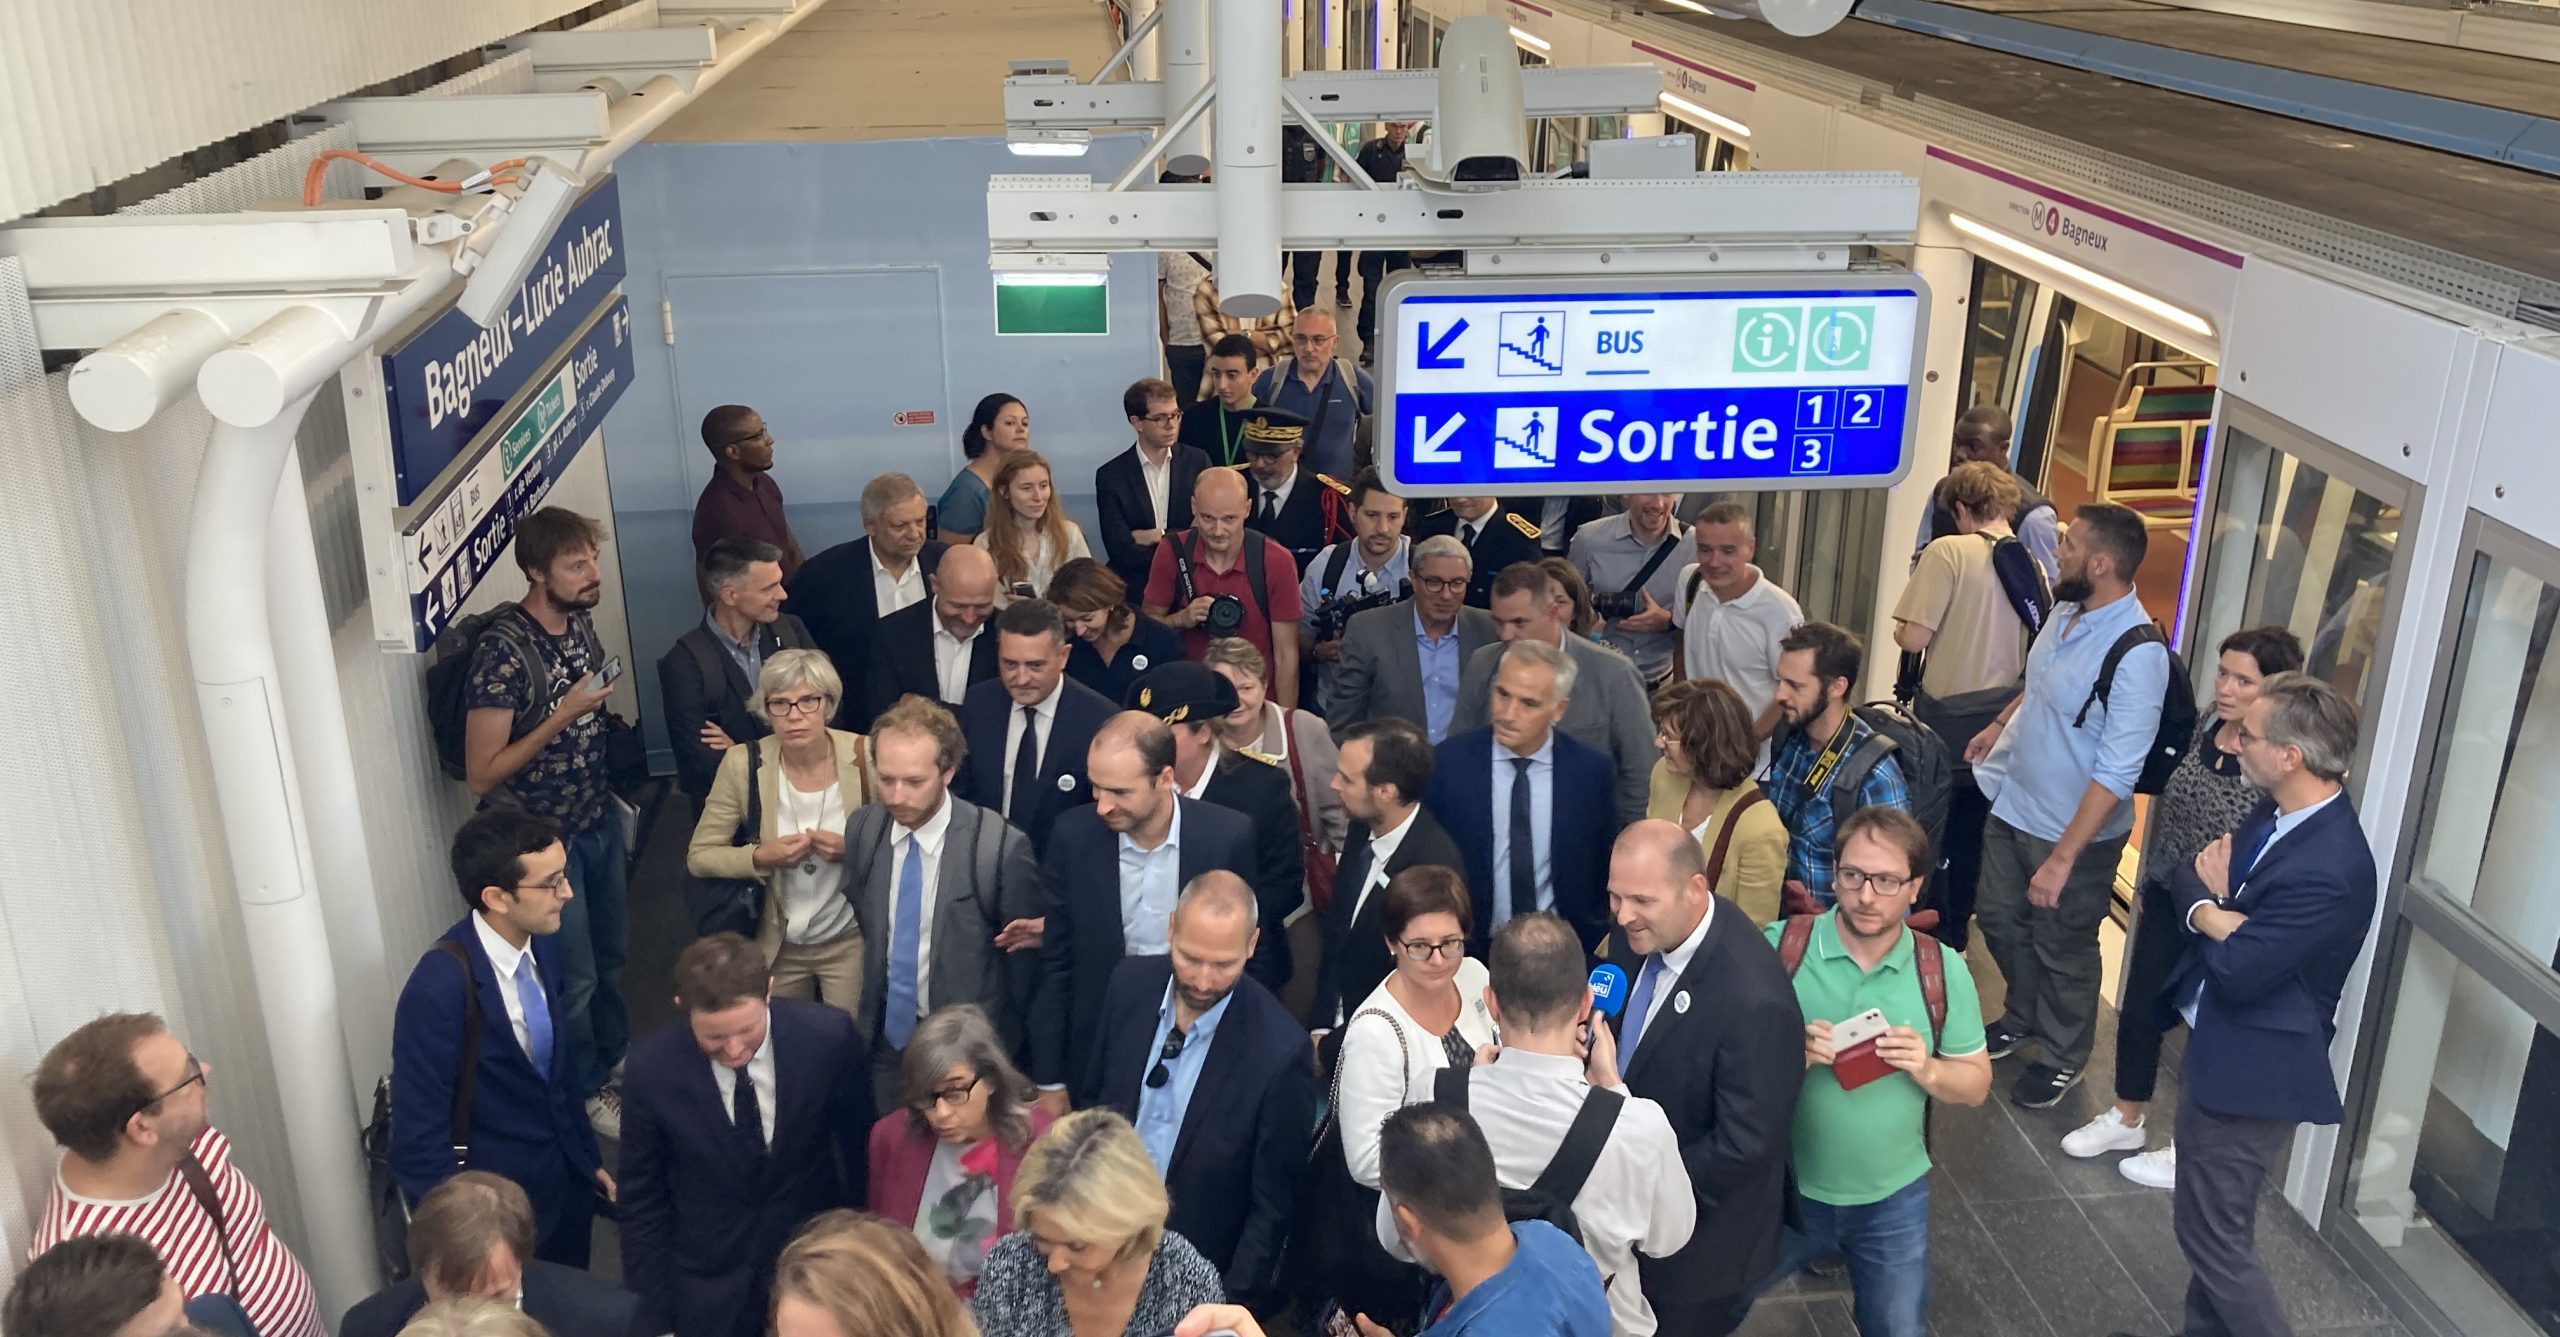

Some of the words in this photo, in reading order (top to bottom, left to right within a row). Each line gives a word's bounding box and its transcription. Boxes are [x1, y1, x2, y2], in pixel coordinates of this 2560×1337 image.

[567, 219, 613, 294] Aubrac
[2062, 217, 2109, 252] Bagneux
[1597, 330, 1644, 354] BUS
[575, 345, 599, 389] Sortie
[1577, 404, 1778, 463] Sortie
[1807, 394, 1823, 425] 1
[1851, 393, 1873, 424] 2
[1800, 438, 1822, 469] 3
[474, 512, 507, 573] Sortie
